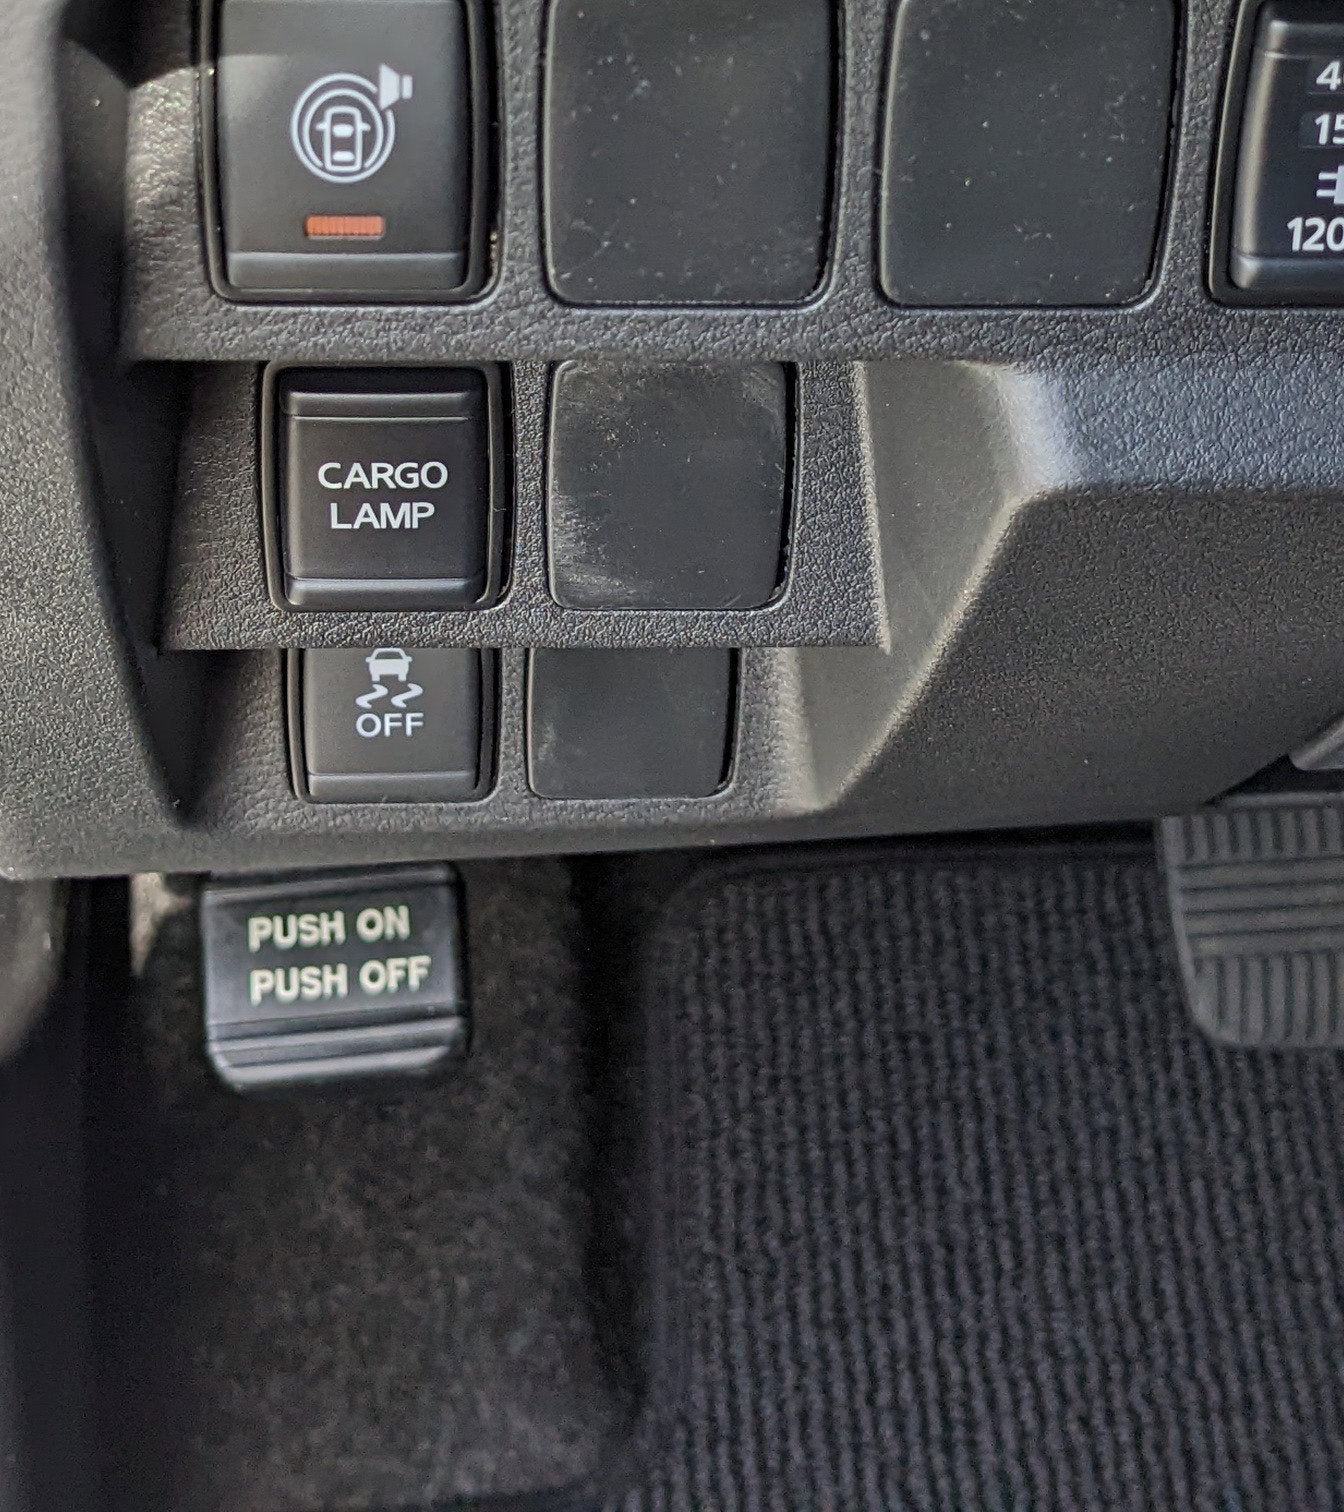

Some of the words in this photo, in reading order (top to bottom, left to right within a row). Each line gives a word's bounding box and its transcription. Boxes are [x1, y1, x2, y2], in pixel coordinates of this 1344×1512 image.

[316, 461, 450, 490] CARGO
[330, 501, 436, 530] LAMP
[355, 712, 424, 739] OFF
[247, 909, 346, 953] PUSH
[356, 904, 411, 943] ON
[249, 962, 349, 1007] PUSH
[359, 954, 432, 995] OFF
